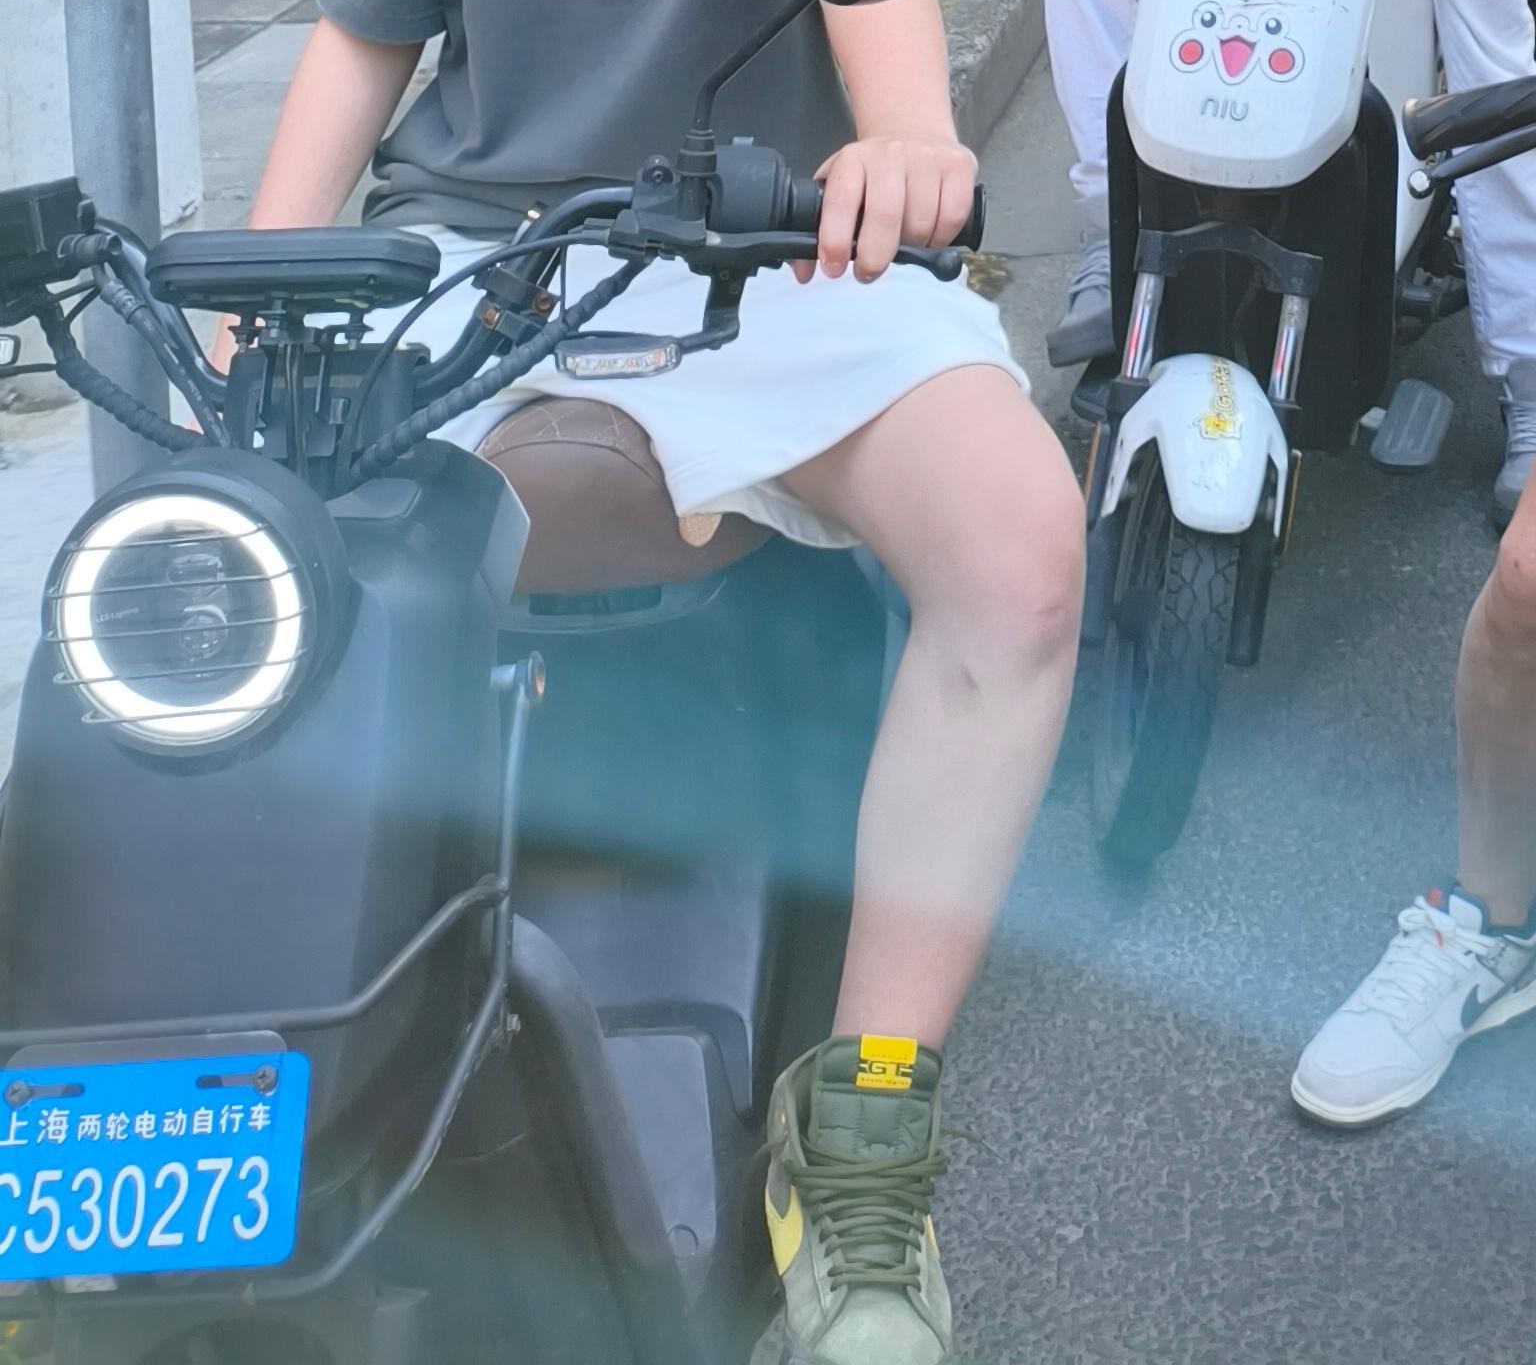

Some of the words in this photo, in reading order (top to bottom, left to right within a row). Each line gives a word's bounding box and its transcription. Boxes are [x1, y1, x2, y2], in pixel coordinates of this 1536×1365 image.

[0, 1101, 272, 1146] 上海两轮电动自行车
[0, 1155, 270, 1256] C530273
